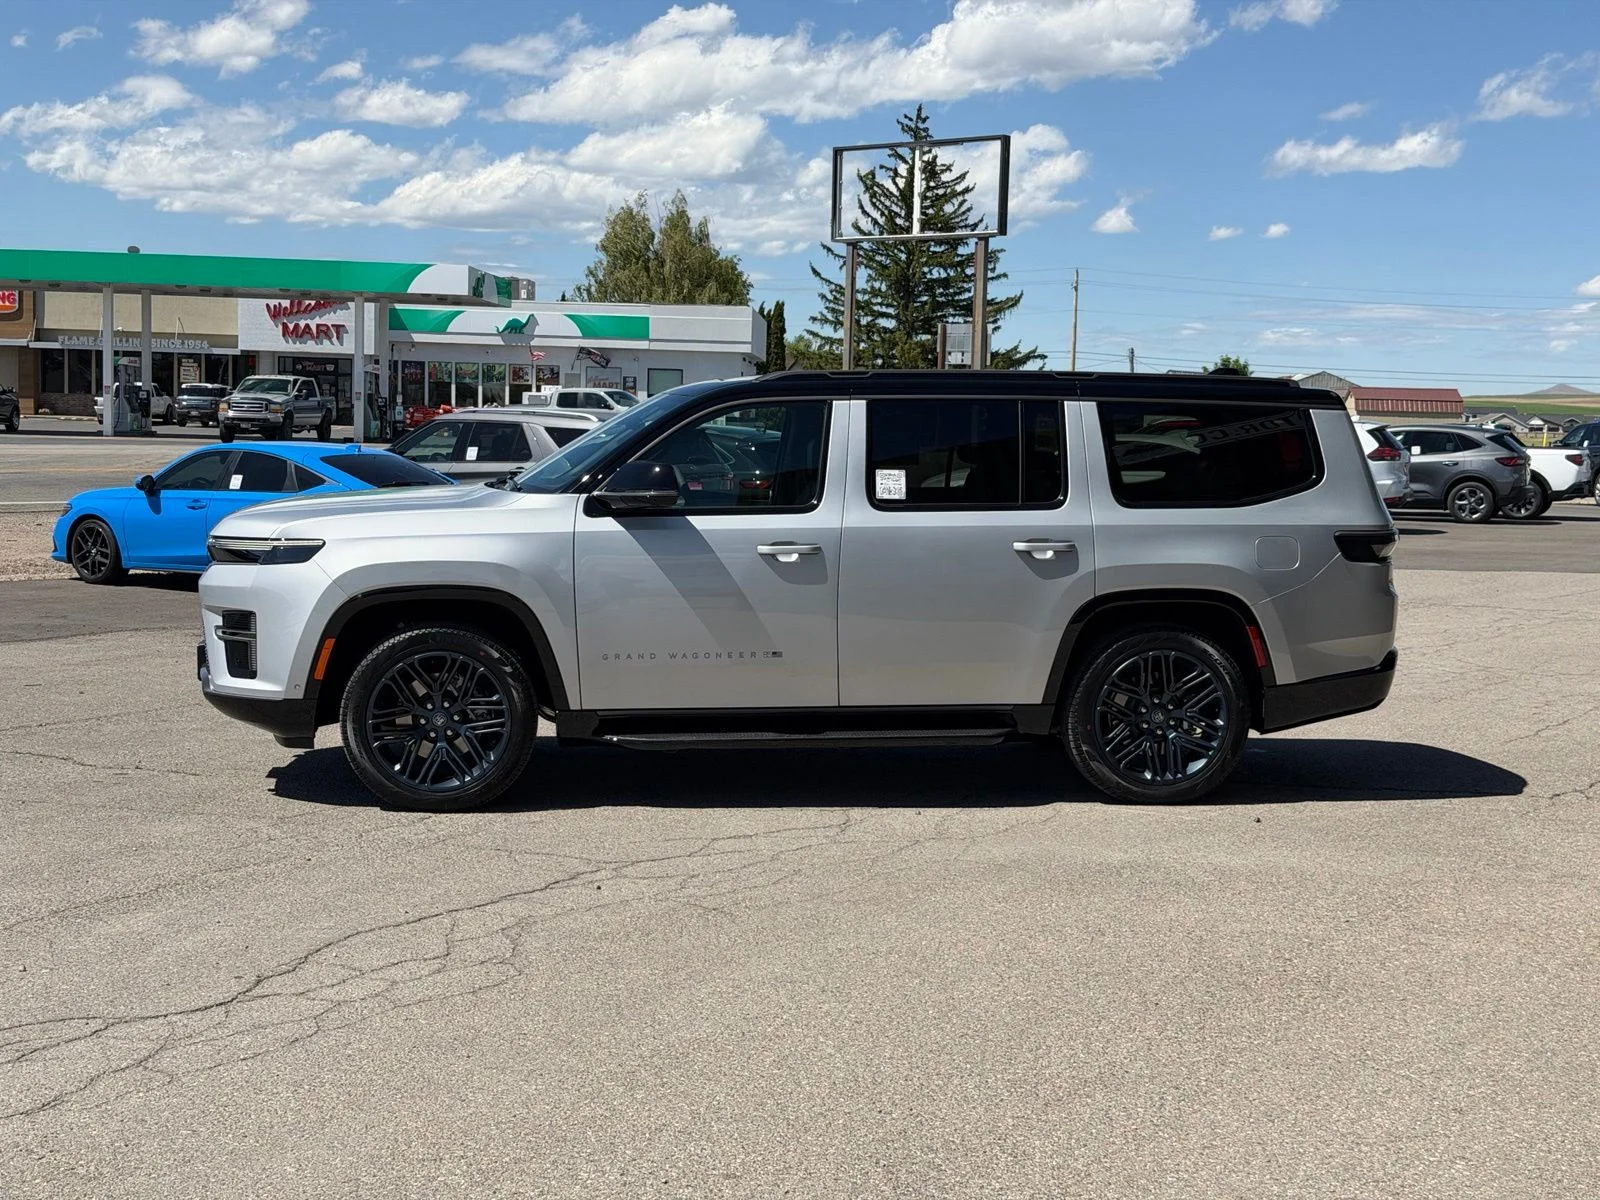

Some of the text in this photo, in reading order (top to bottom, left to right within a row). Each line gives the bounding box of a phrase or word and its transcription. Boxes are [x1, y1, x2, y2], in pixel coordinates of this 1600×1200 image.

[282, 322, 346, 342] MART
[58, 335, 209, 349] FLAME GILLIN SINCE 1954
[602, 652, 656, 661] GRAND
[668, 651, 757, 660] WAGONEER
